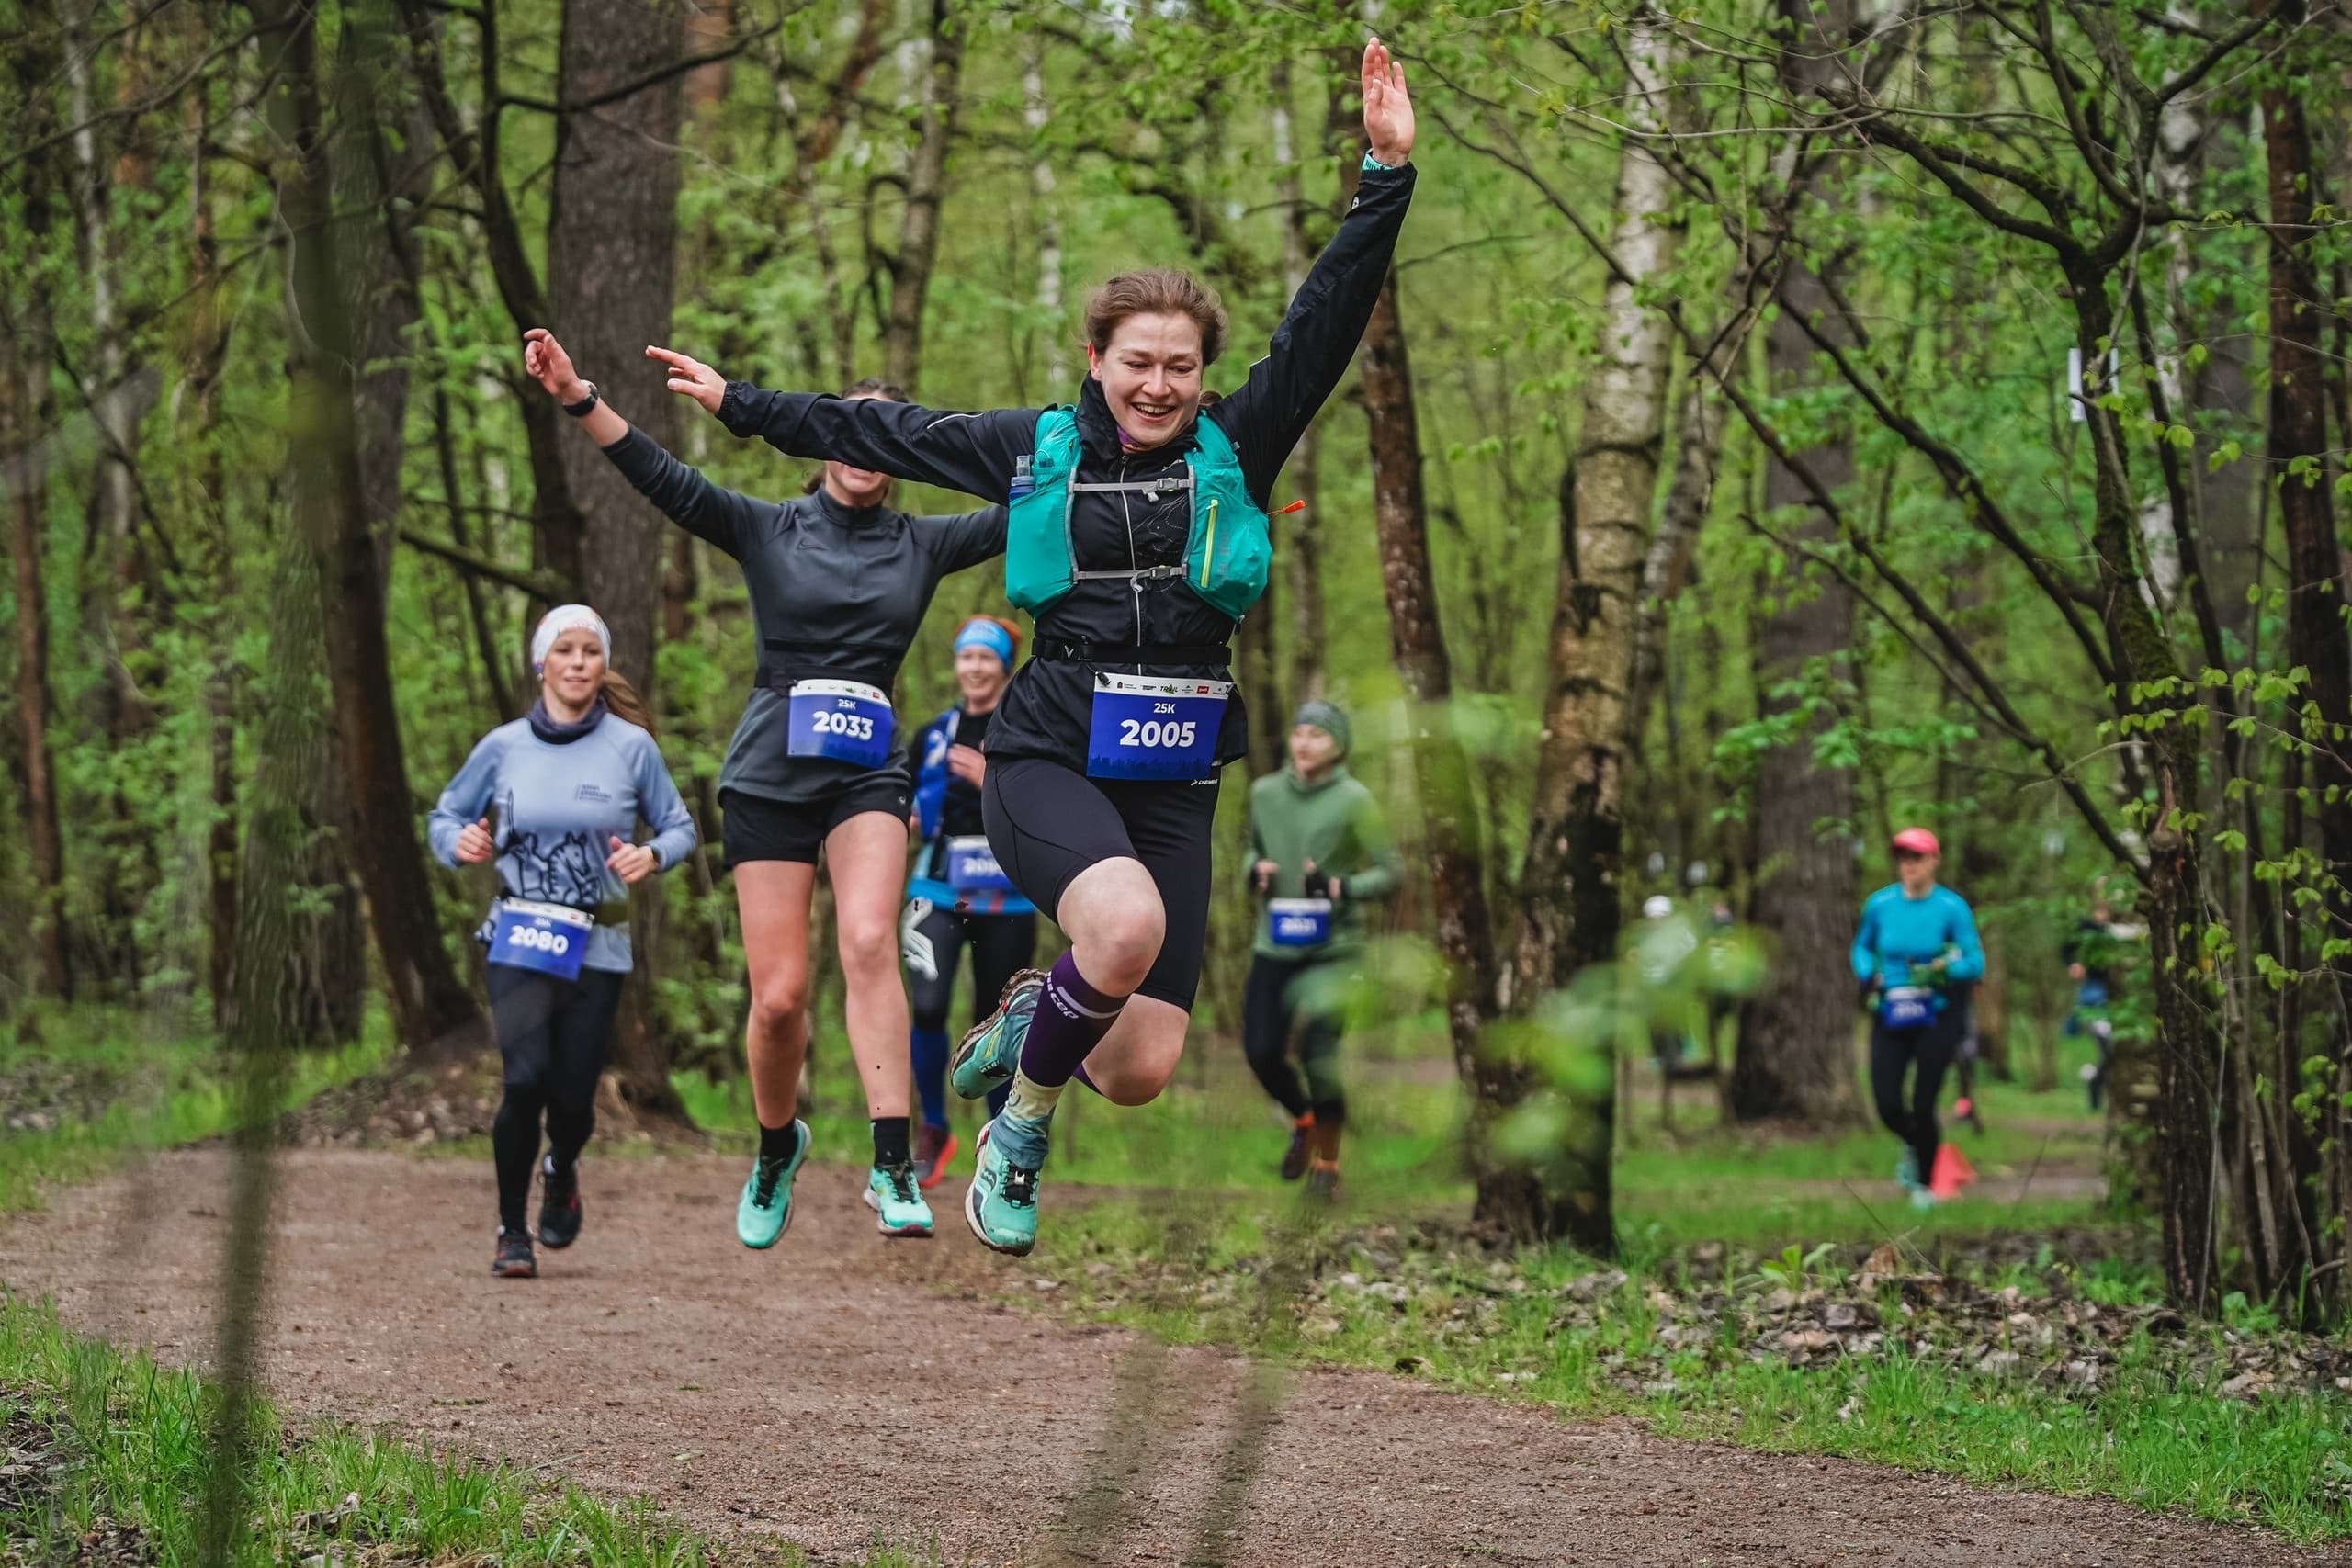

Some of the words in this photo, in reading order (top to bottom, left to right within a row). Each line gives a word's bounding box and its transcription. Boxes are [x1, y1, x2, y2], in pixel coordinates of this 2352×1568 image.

[837, 699, 856, 710] 25K
[1154, 703, 1176, 714] 25K
[812, 711, 874, 741] 2033
[1119, 719, 1196, 748] 2005
[509, 925, 569, 955] 2080
[1050, 993, 1079, 1019] cep
